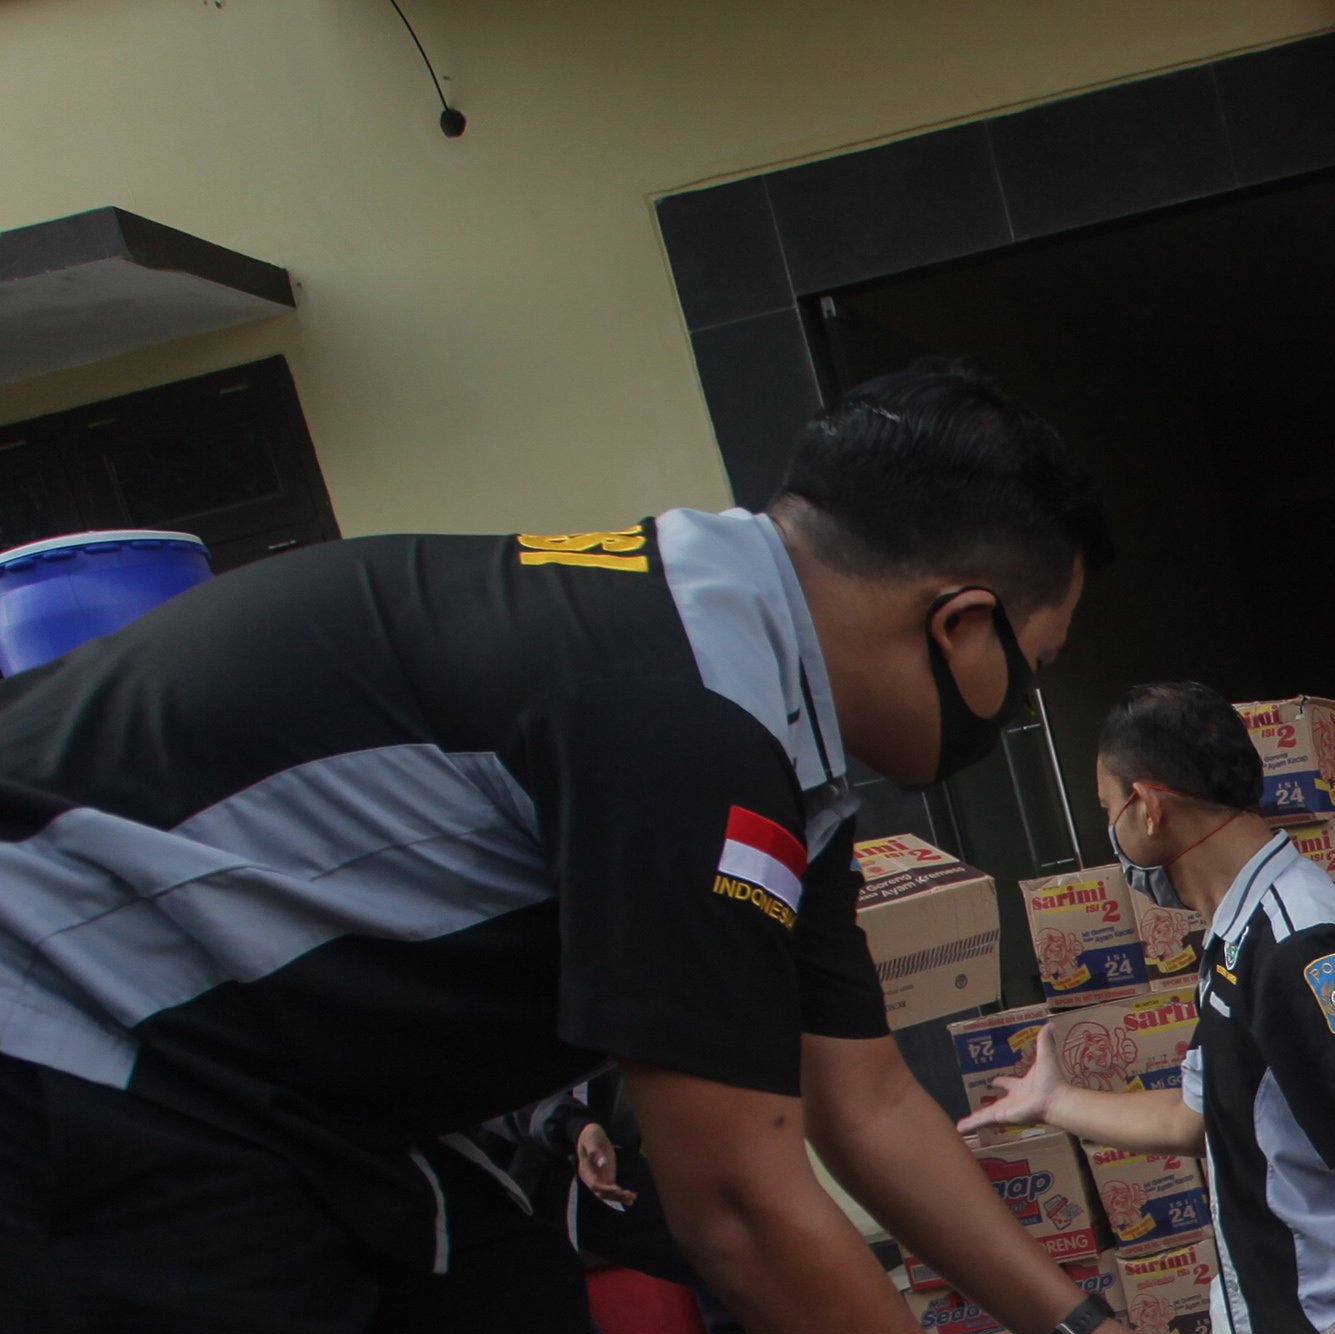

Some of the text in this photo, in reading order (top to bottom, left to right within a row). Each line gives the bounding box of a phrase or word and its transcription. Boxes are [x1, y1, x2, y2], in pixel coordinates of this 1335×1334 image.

[1261, 725, 1297, 748] ISI 2
[1274, 788, 1304, 806] 24
[909, 848, 941, 863] 2
[866, 873, 913, 893] Goreng
[881, 866, 966, 899] Ayam Kremess
[1032, 881, 1107, 911] sarimi
[1086, 900, 1121, 923] ISI 2
[1104, 961, 1133, 977] 24
[1168, 1206, 1197, 1225] 24
[1125, 1246, 1198, 1277] sarimi
[1192, 1264, 1212, 1285] 2
